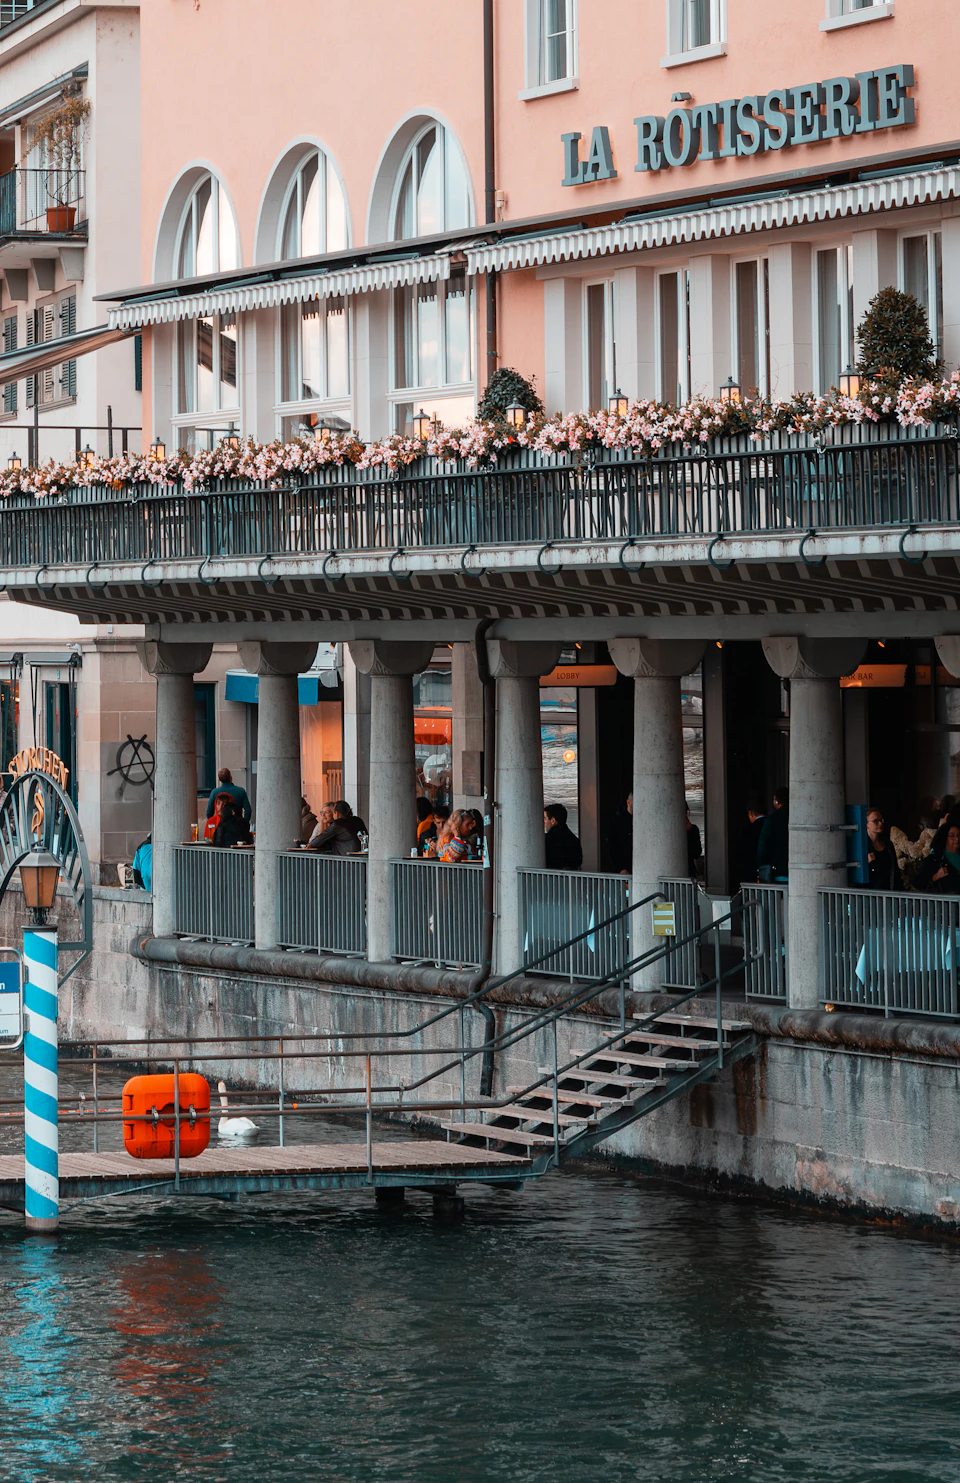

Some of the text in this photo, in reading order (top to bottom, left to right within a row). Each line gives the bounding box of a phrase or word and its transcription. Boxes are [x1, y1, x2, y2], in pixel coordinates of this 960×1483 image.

[561, 64, 915, 187] LA RÔTISSERIE
[556, 672, 580, 680] LOBBY
[858, 672, 873, 680] BAR
[8, 746, 70, 791] STORCHEN
